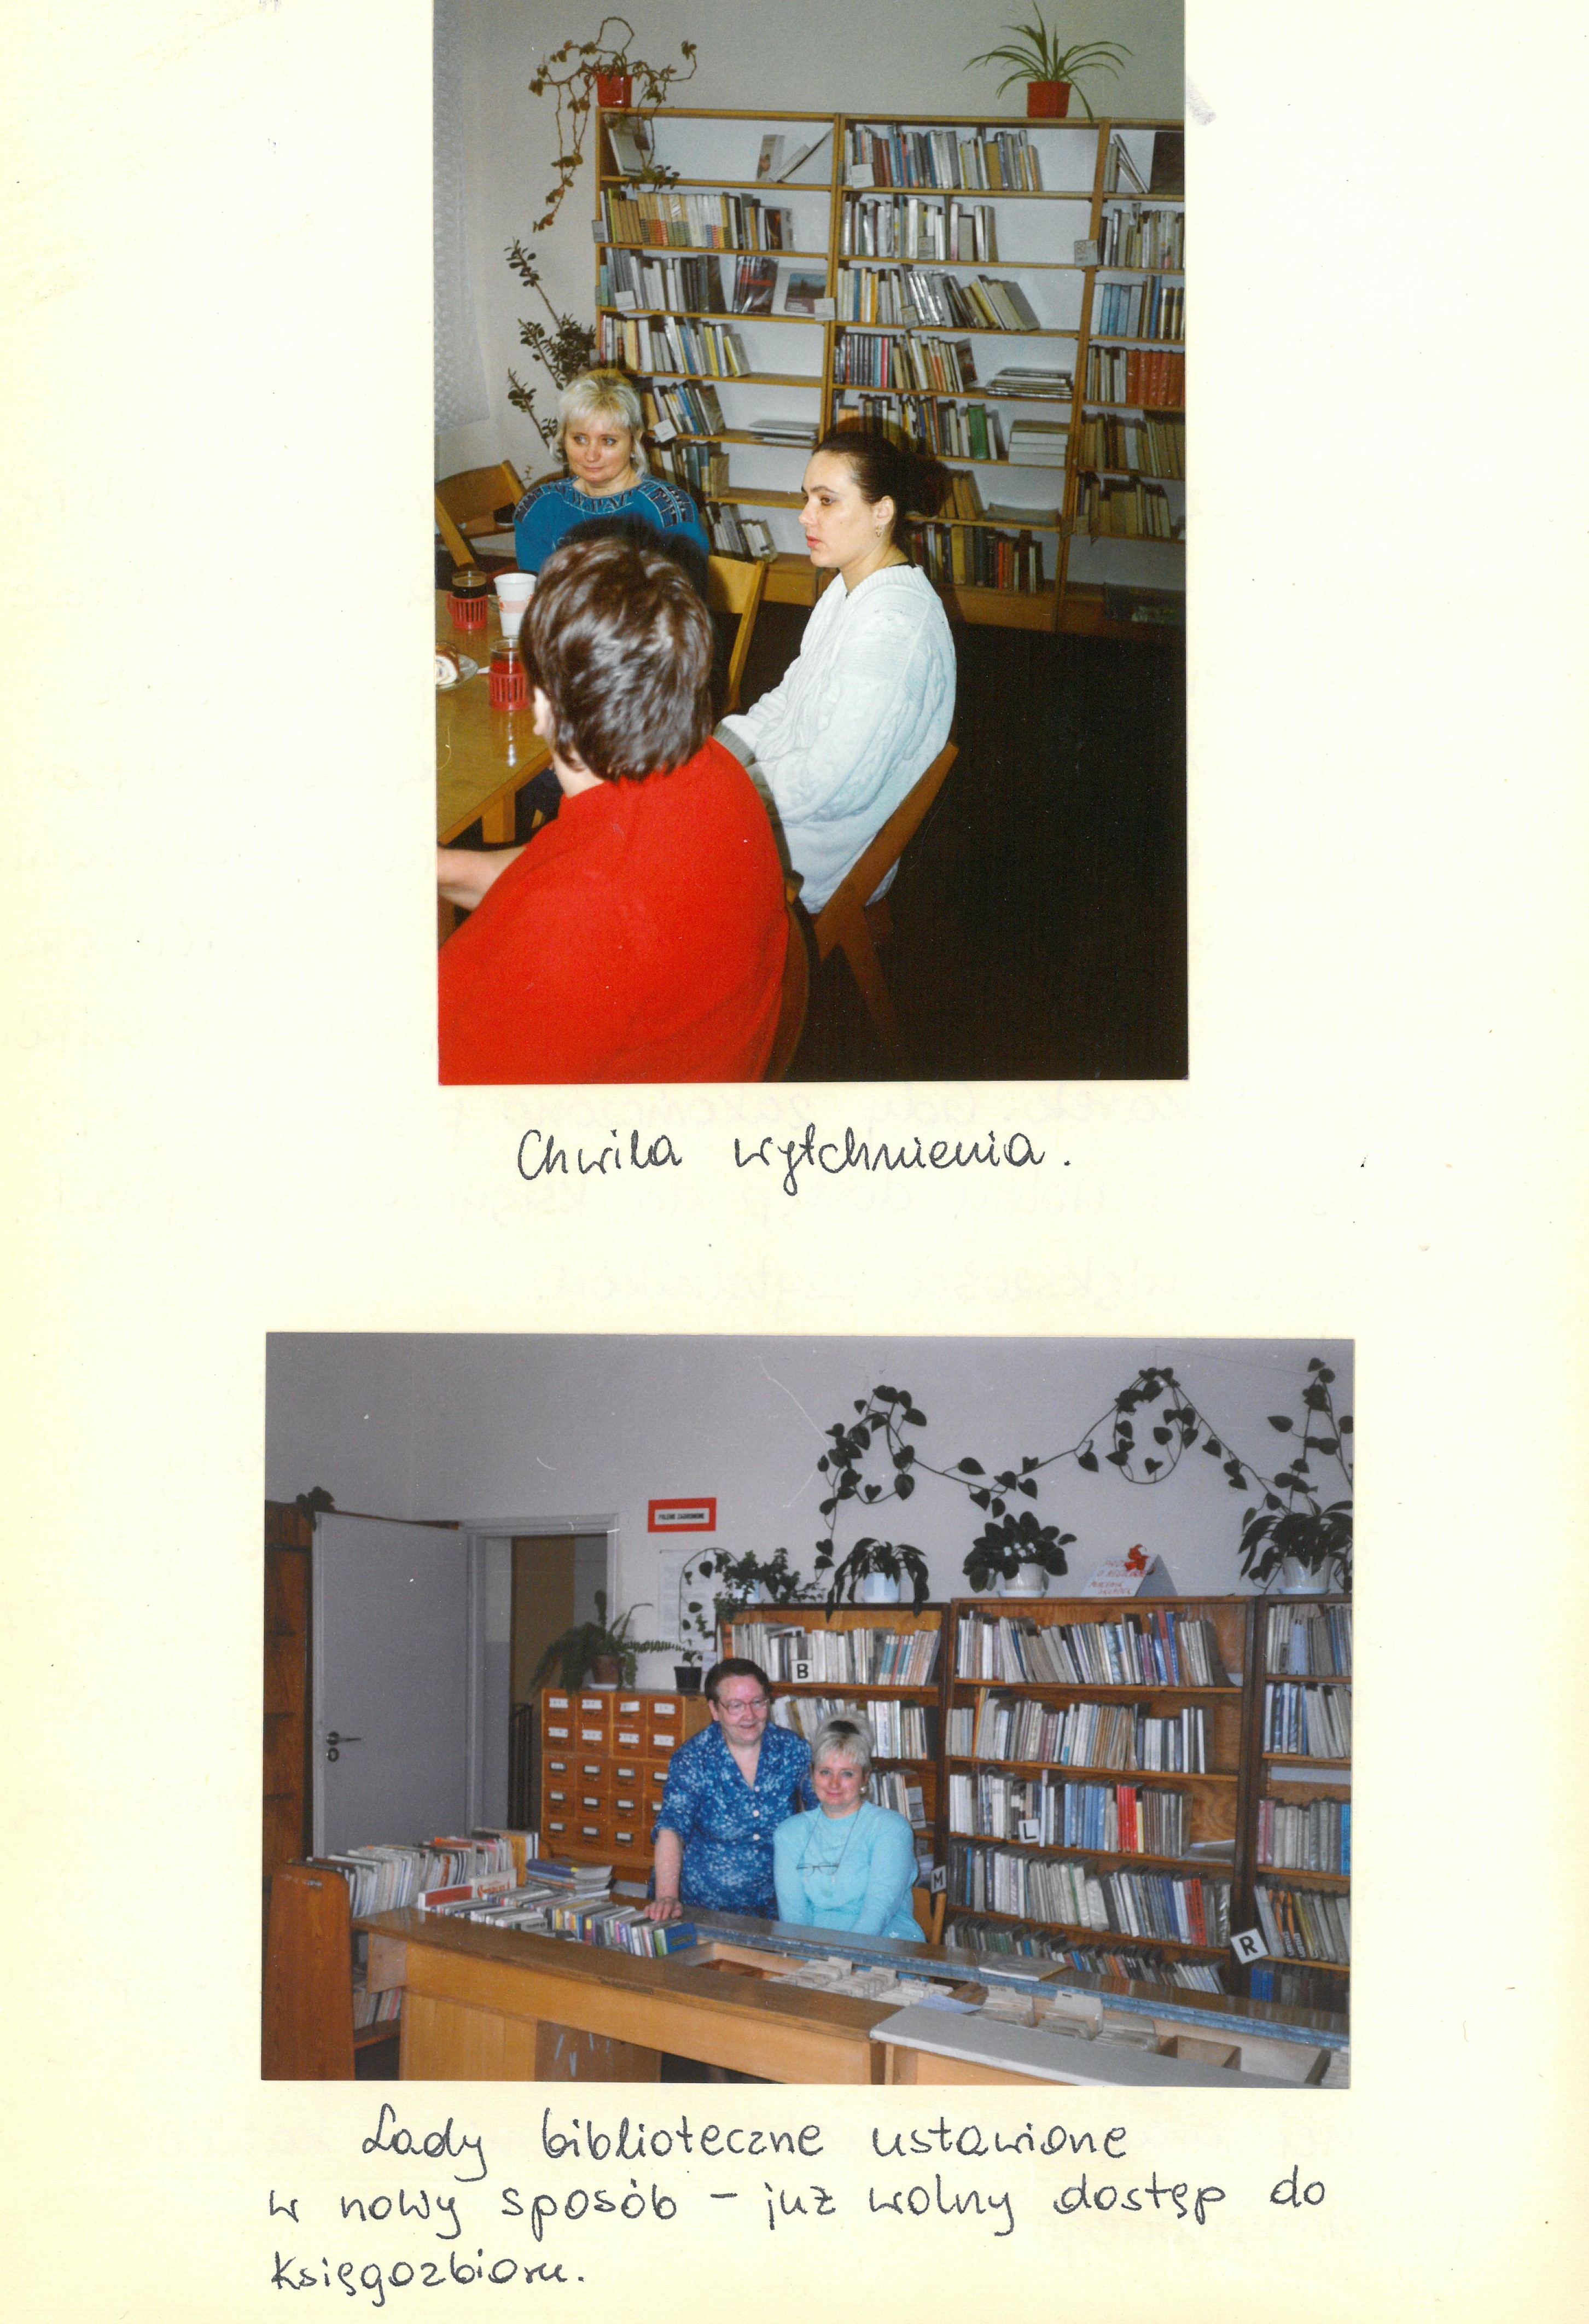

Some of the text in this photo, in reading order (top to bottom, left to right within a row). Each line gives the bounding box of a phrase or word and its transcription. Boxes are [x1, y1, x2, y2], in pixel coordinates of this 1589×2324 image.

[517, 1128, 683, 1181] Chwila
[797, 1663, 808, 1679] B
[1023, 1823, 1037, 1839] L
[934, 1870, 943, 1889] M
[1239, 1936, 1258, 1956] R
[361, 2103, 1126, 2182] Lady biblioteczne ustawione
[269, 2190, 299, 2223] w
[340, 2188, 462, 2240] nowy
[501, 2177, 677, 2242] sposób
[868, 2173, 1015, 2238] wolny
[1052, 2171, 1226, 2226] dostęp
[1269, 2164, 1326, 2209] do
